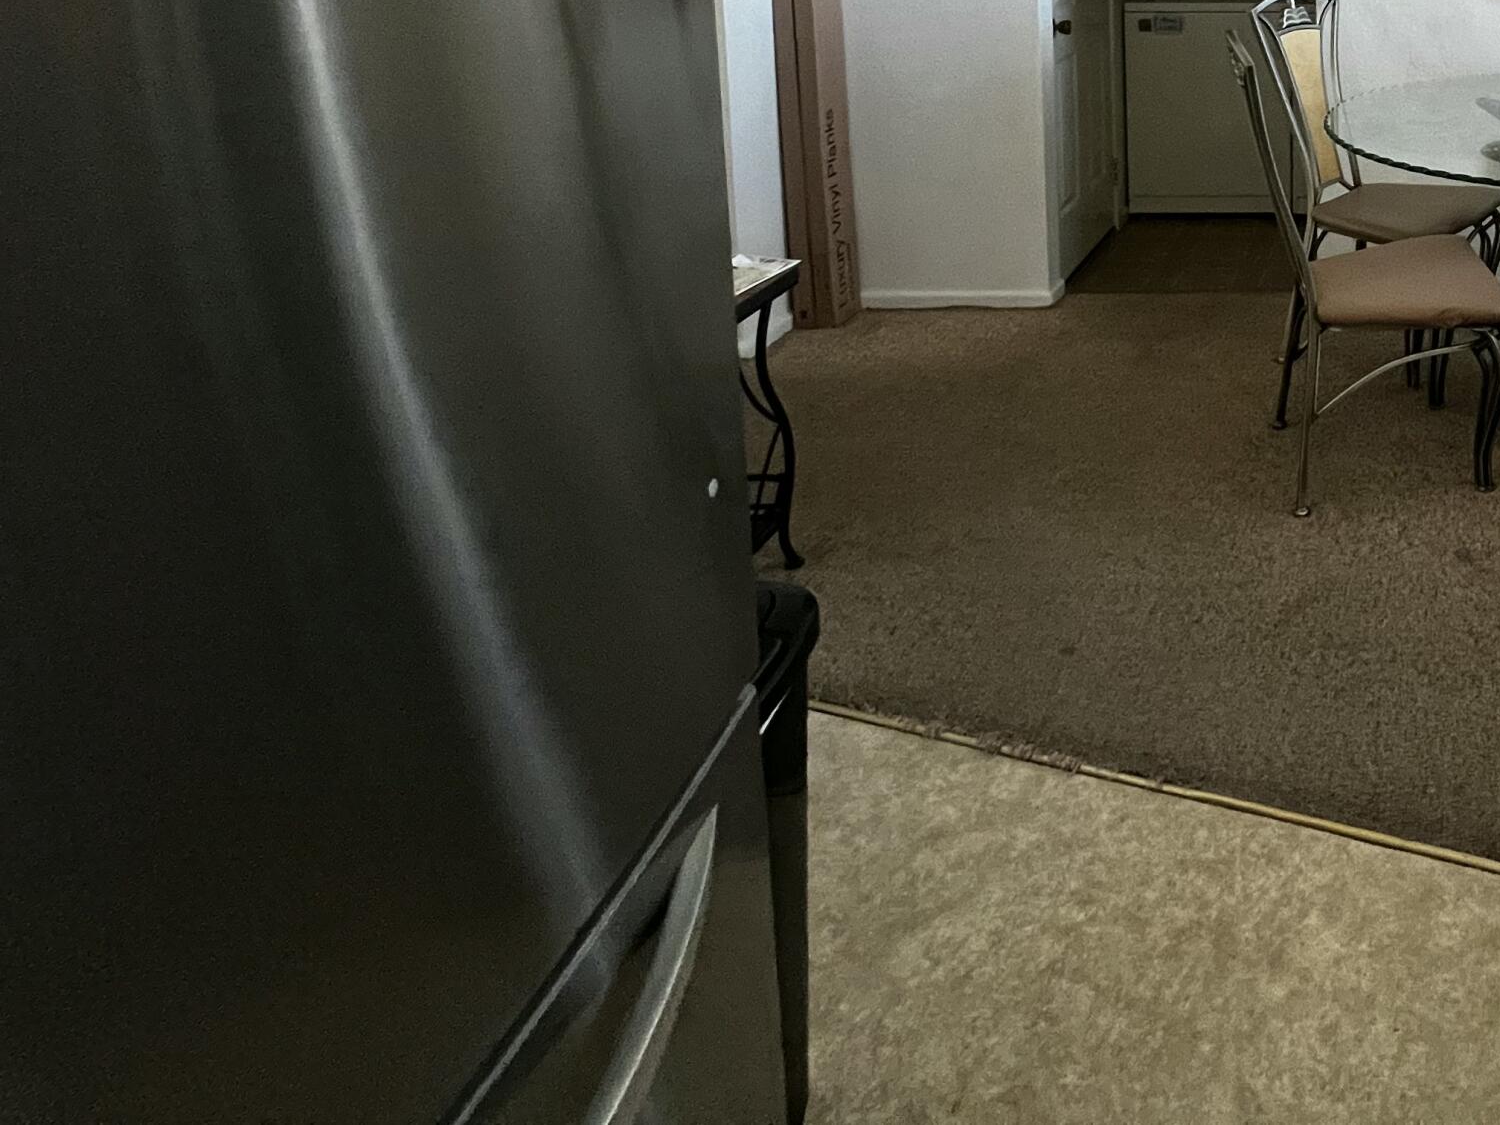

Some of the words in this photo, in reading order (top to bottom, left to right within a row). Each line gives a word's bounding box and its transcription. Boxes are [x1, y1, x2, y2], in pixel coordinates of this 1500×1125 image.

[825, 108, 838, 179] Planks
[828, 183, 842, 235] Vinyl
[836, 240, 848, 309] Luxury
